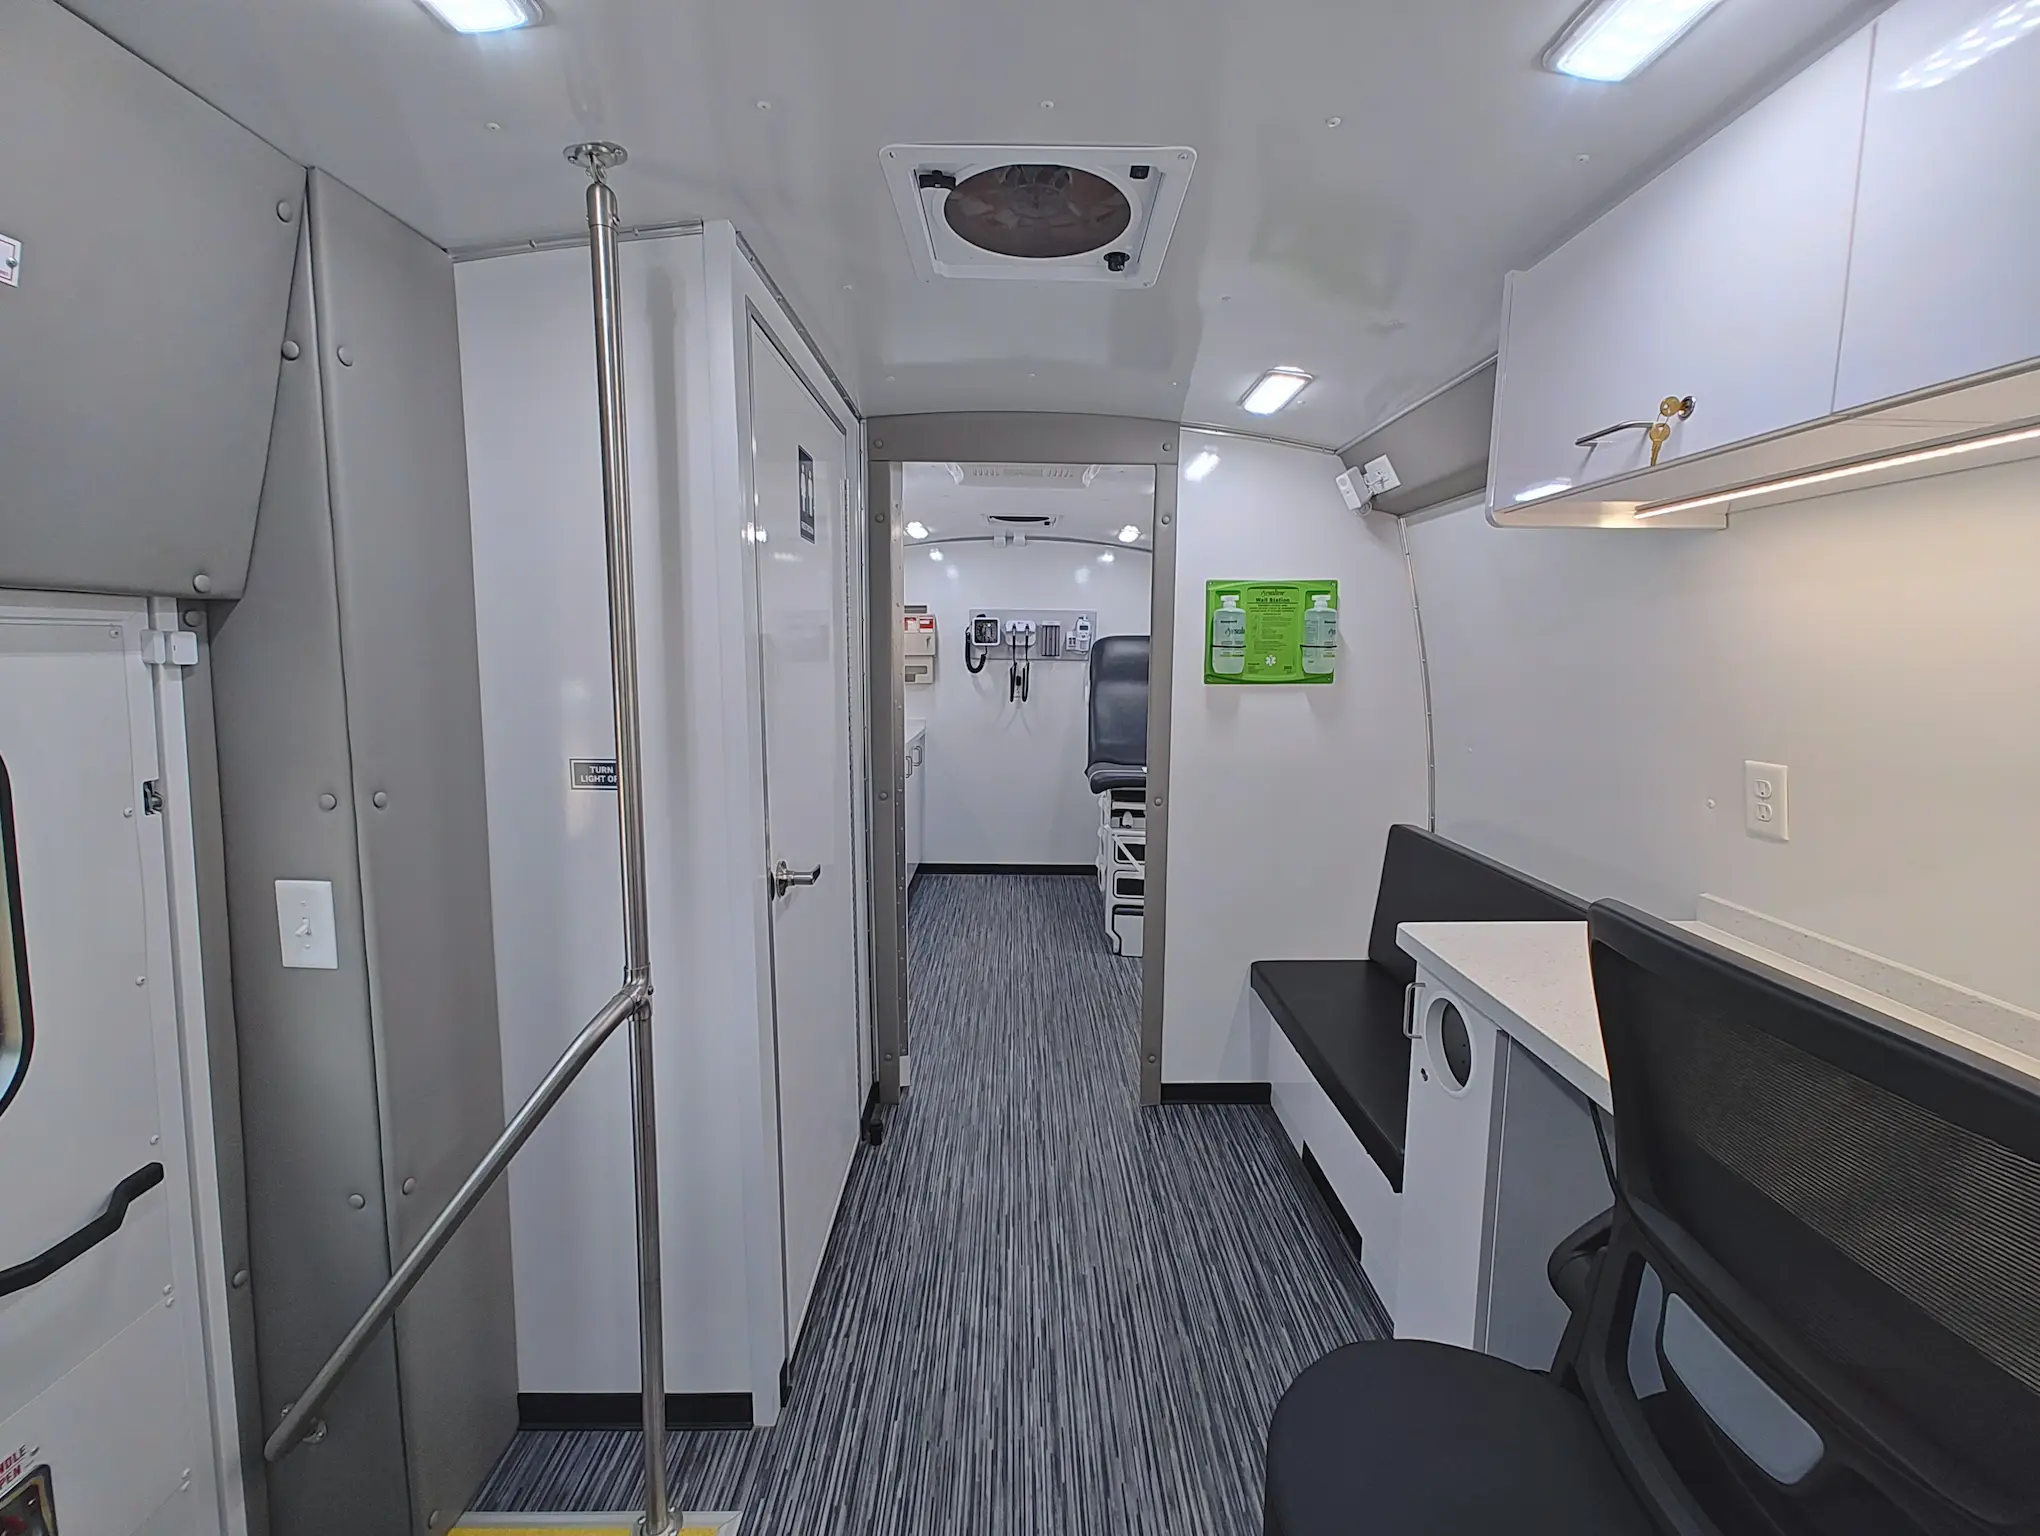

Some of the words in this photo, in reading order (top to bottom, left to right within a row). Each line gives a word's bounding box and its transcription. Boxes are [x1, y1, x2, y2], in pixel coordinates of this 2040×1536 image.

[589, 766, 614, 774] TURN
[581, 775, 606, 783] LIGHT
[607, 775, 617, 783] OF
